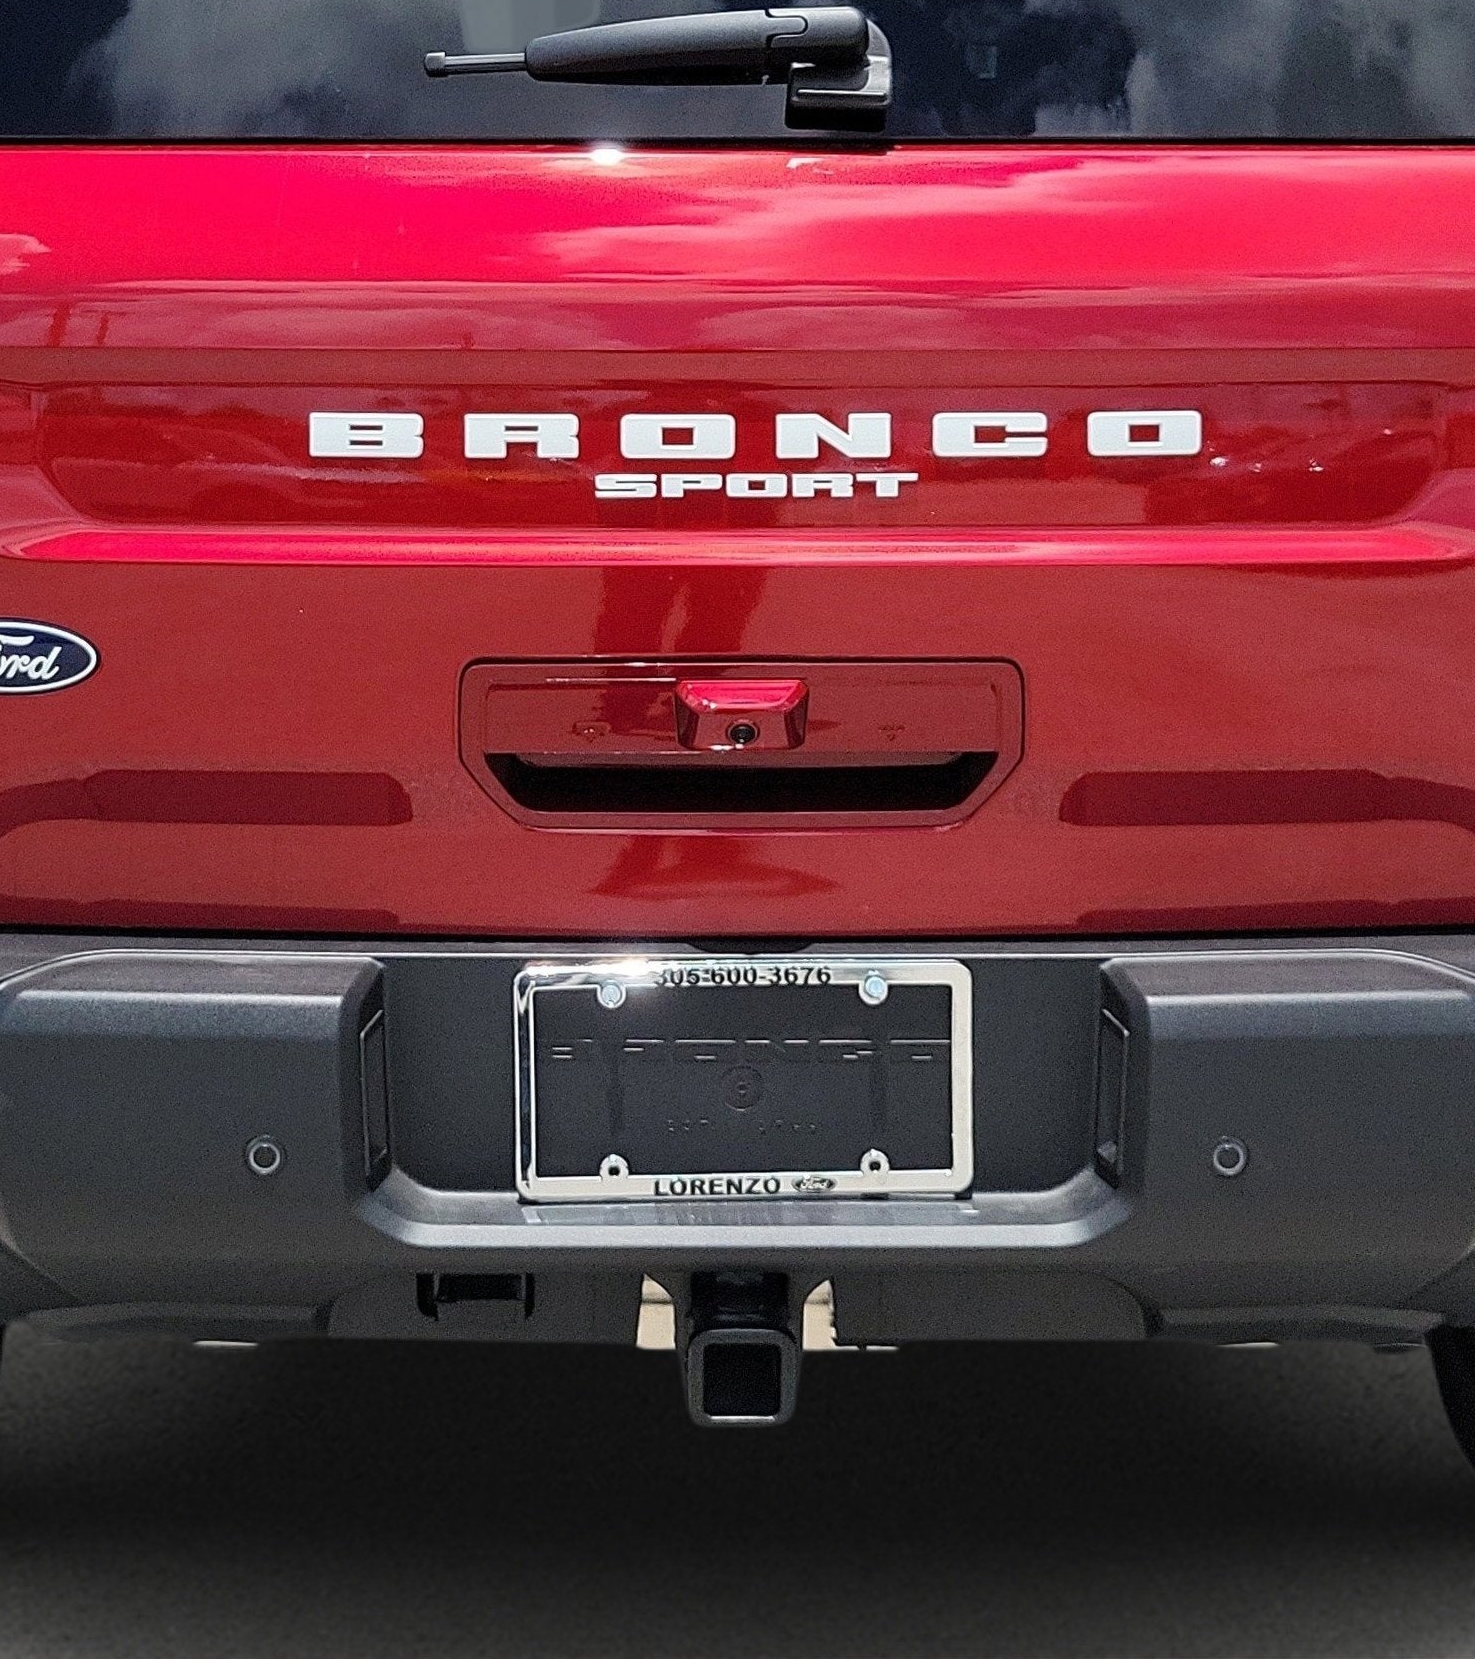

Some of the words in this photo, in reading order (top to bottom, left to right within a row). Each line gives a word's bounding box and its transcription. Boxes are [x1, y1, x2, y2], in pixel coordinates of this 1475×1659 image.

[308, 410, 1204, 460] BRONCO
[593, 472, 920, 499] SPORT
[653, 965, 832, 986] 305-600-3676
[653, 1176, 782, 1197] LORENZO
